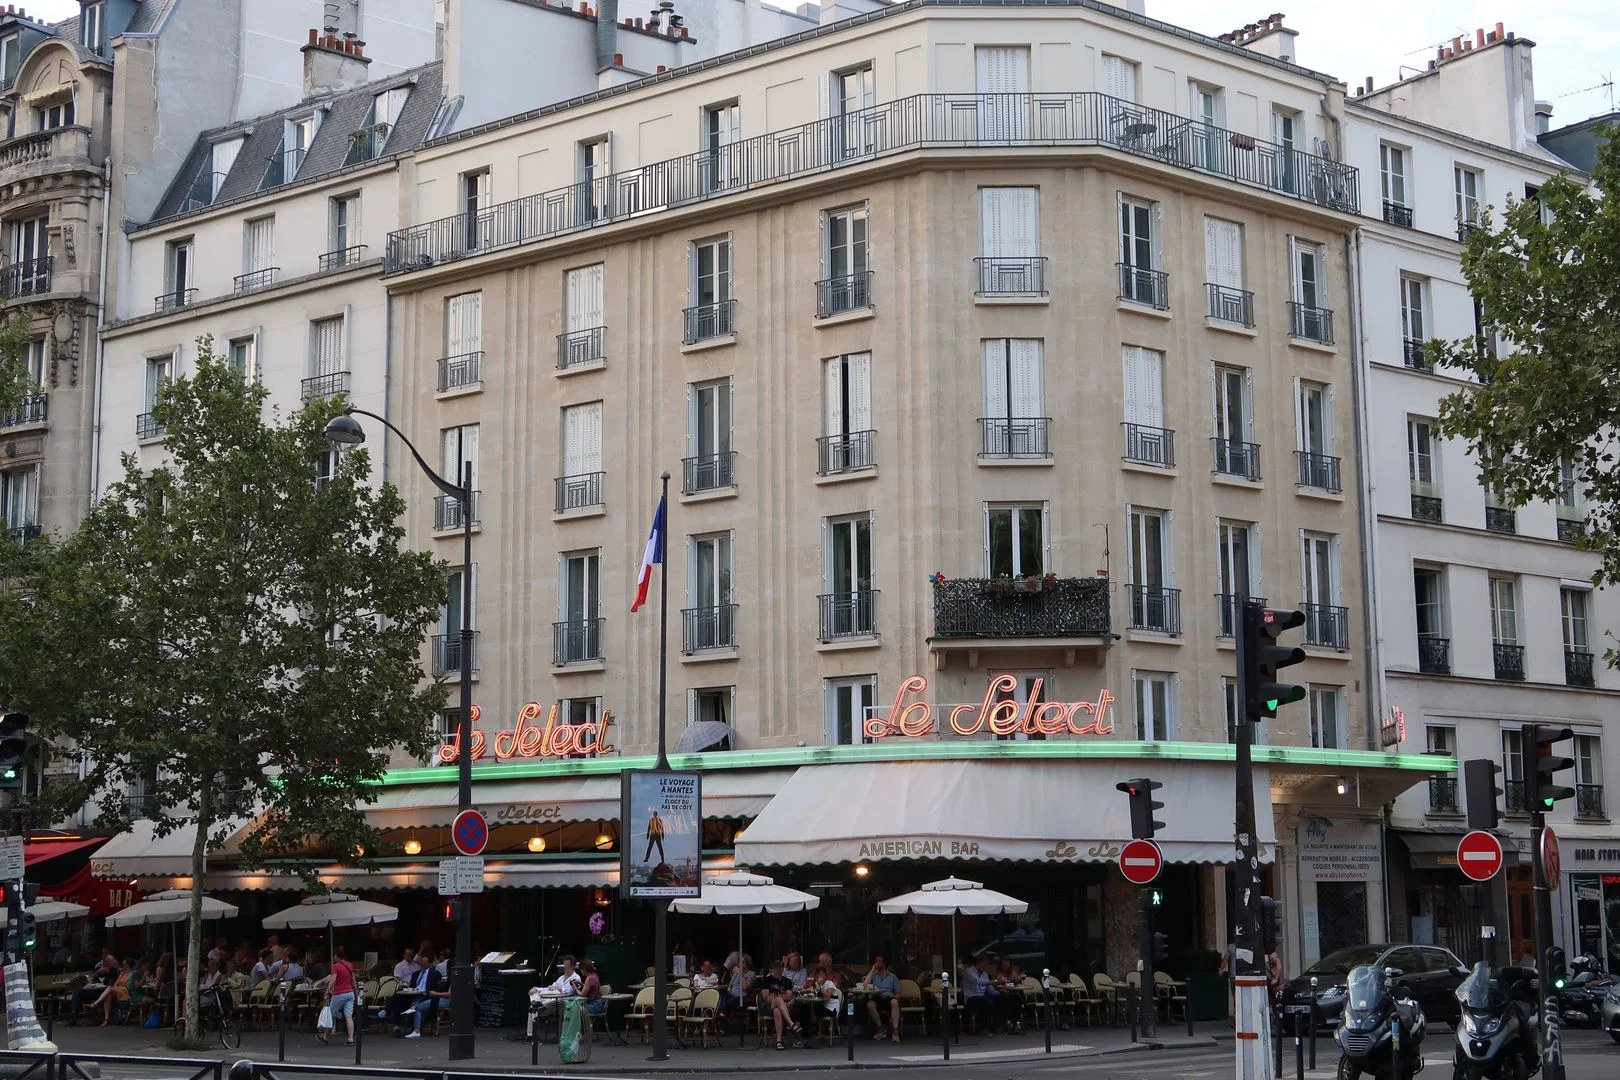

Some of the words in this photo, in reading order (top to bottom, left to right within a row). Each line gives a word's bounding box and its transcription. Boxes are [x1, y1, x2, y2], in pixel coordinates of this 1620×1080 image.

[863, 674, 935, 738] Le
[950, 674, 1115, 735] Select
[439, 704, 486, 762] Le
[494, 701, 614, 759] Select
[660, 778, 668, 786] LE
[666, 786, 694, 794] NANTES
[497, 804, 561, 820] Select
[859, 840, 942, 858] AMERICAN
[951, 841, 980, 856] BAR
[1045, 841, 1078, 858] Le
[1575, 849, 1595, 861] HAIR
[109, 888, 133, 908] BAR
